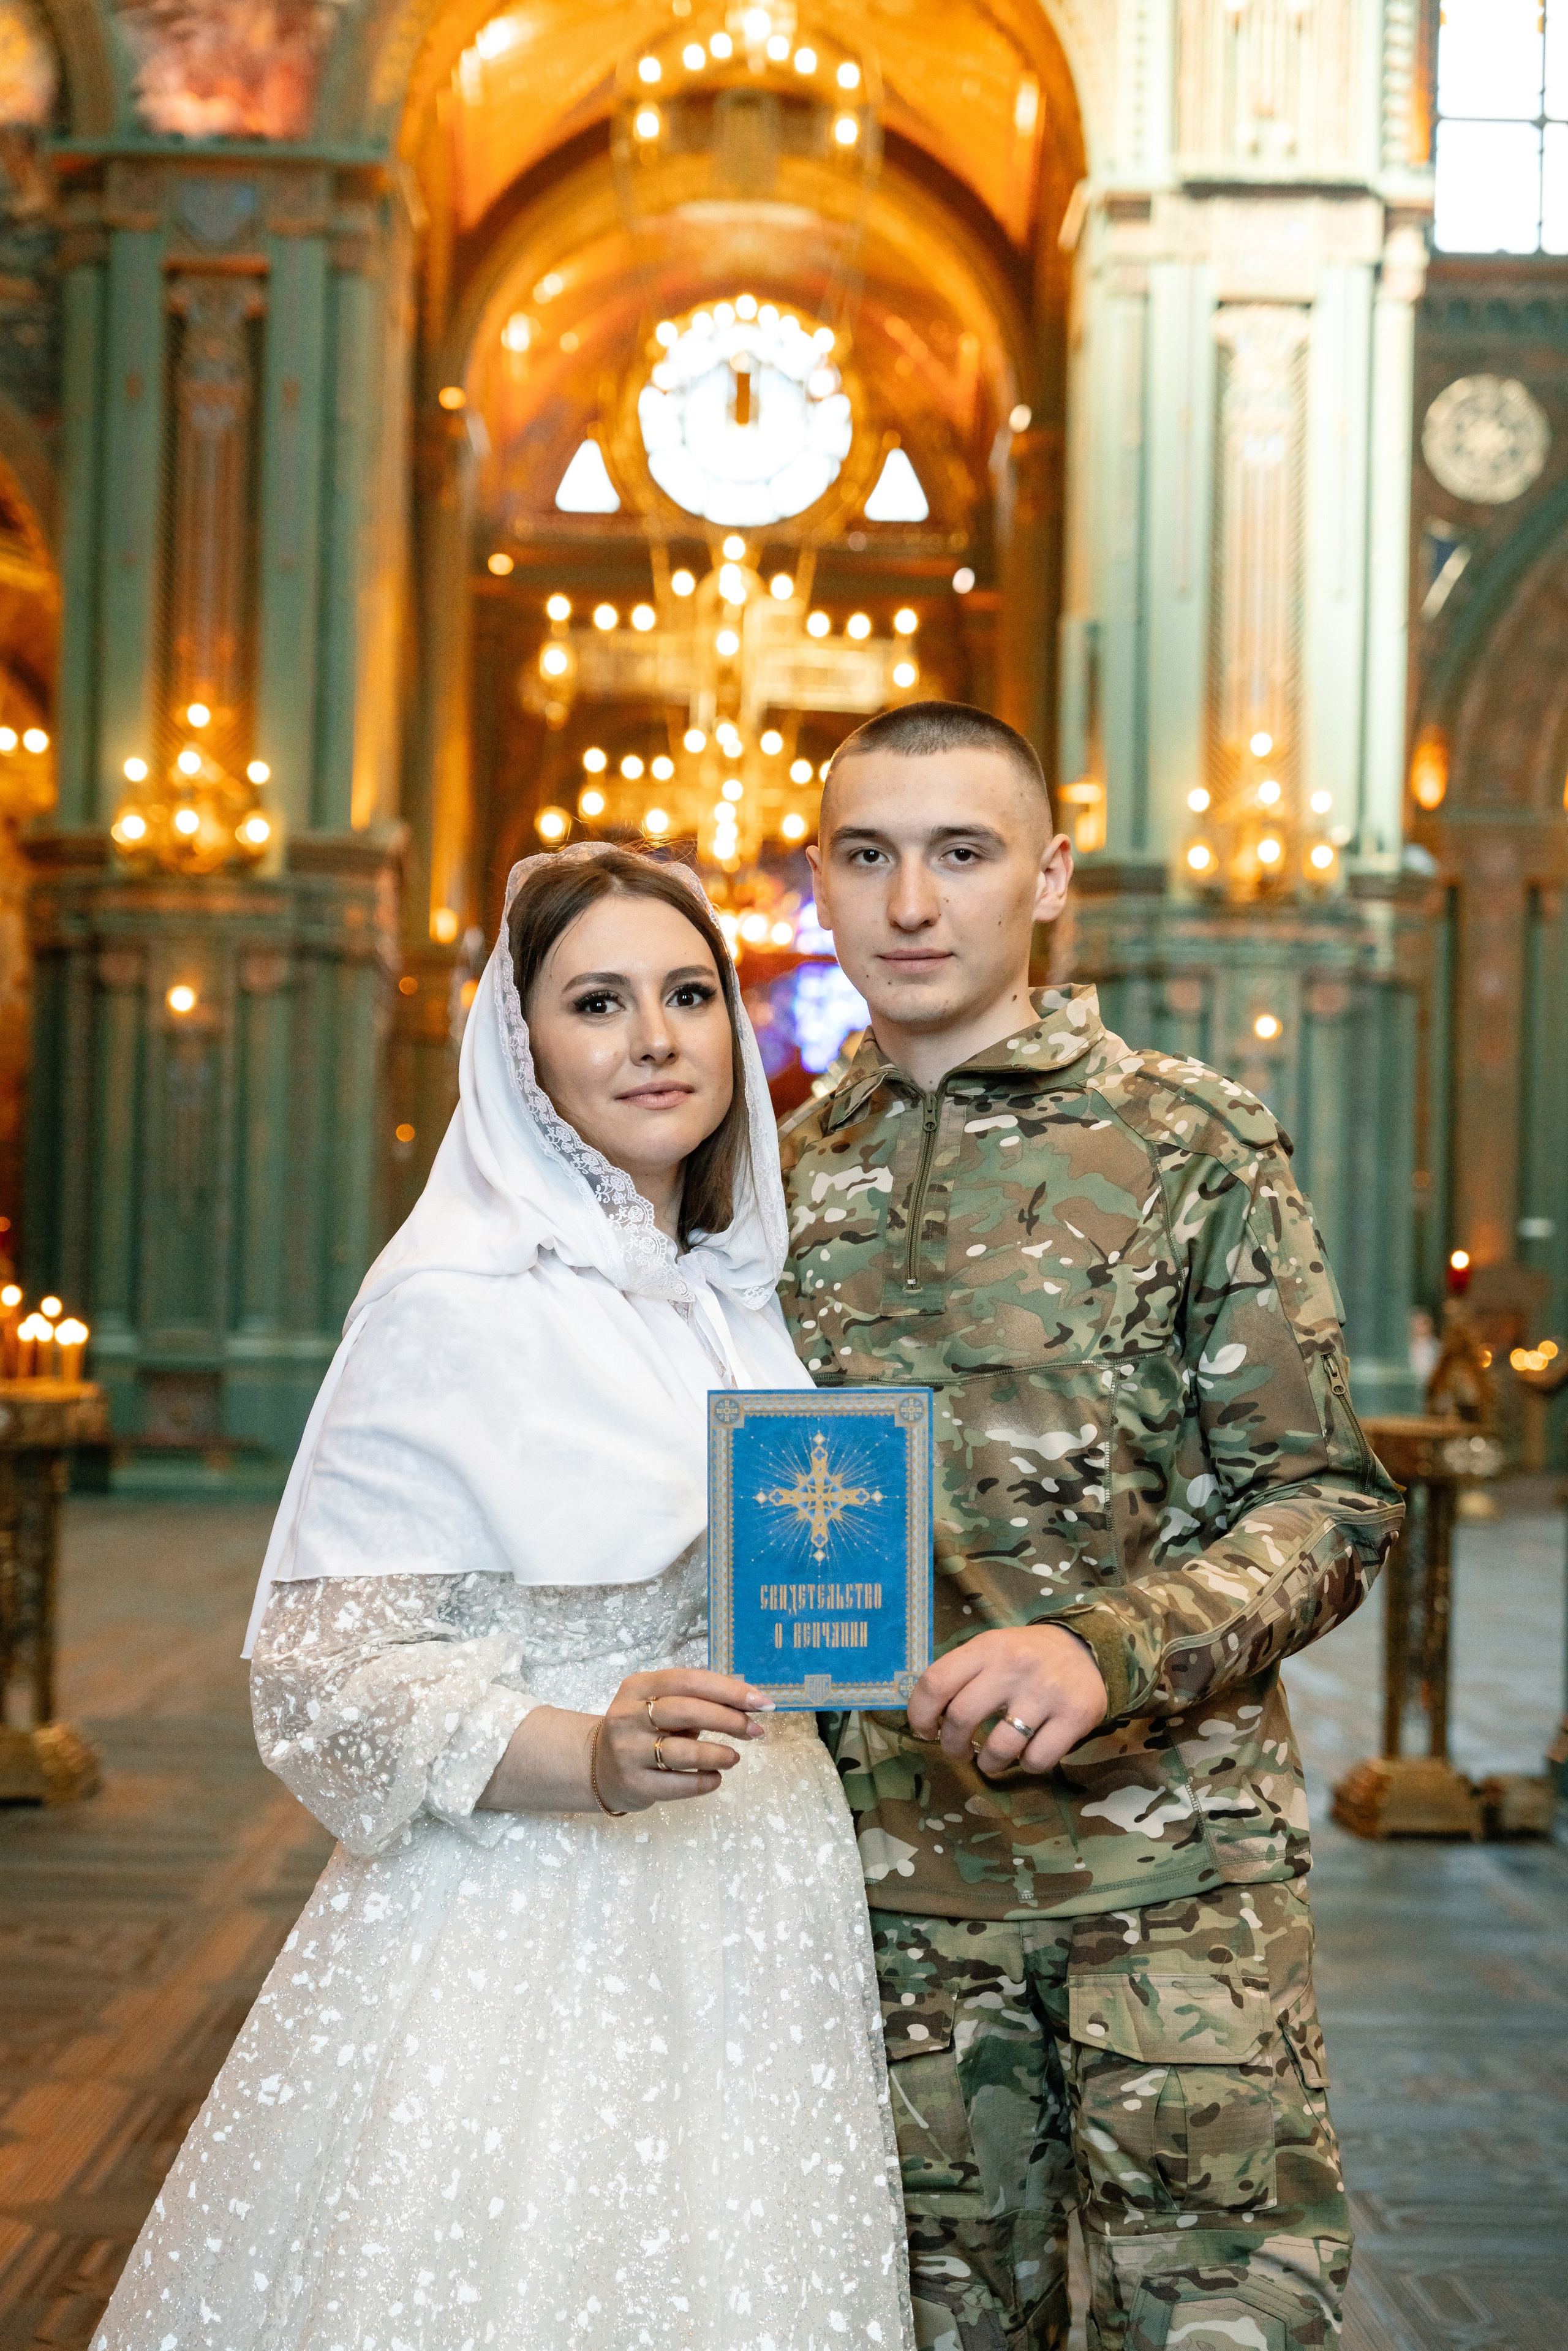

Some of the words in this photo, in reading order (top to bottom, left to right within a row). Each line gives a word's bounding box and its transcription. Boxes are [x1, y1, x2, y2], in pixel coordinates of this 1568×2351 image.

[760, 1583, 882, 1615] СВИДЕТЕЛЬСТВО
[775, 1623, 782, 1648] О
[794, 1622, 867, 1648] ВЕНЧАНИИ
